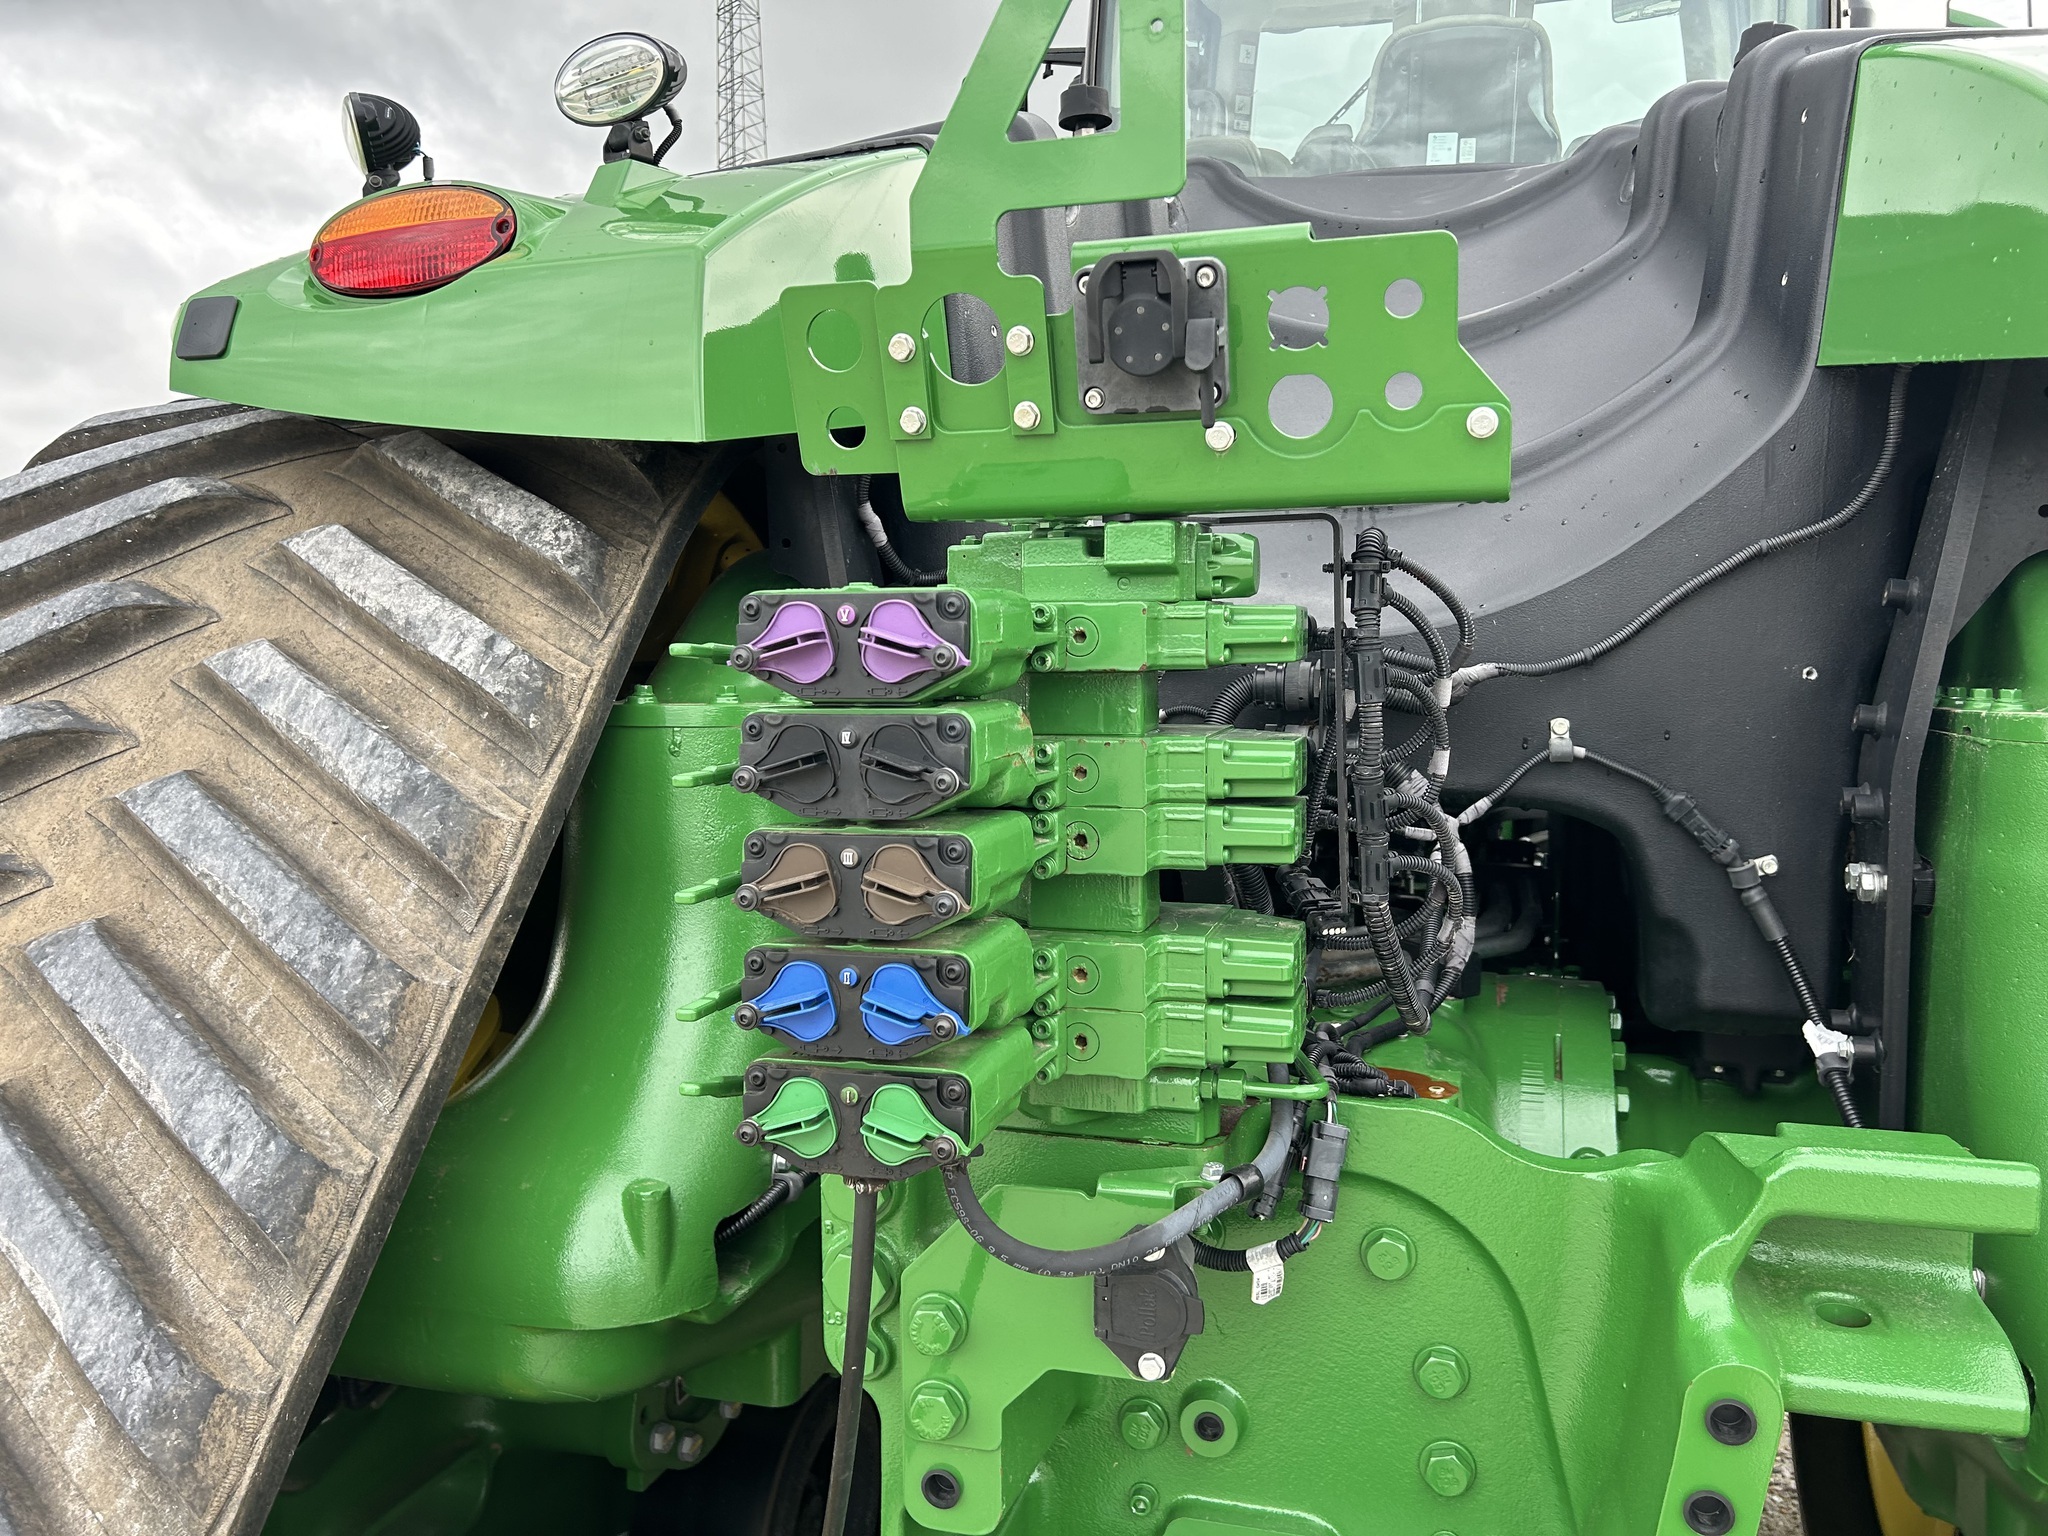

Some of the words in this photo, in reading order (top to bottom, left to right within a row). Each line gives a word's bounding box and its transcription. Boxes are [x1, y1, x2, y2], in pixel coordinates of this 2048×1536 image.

[839, 608, 850, 622] V
[841, 731, 851, 744] IV
[842, 852, 854, 865] III
[843, 971, 851, 985] II
[948, 1187, 985, 1243] FC598-06
[986, 1245, 1009, 1262] 9.5
[1111, 1256, 1139, 1270] DN10
[1138, 1287, 1156, 1337] Pollak
